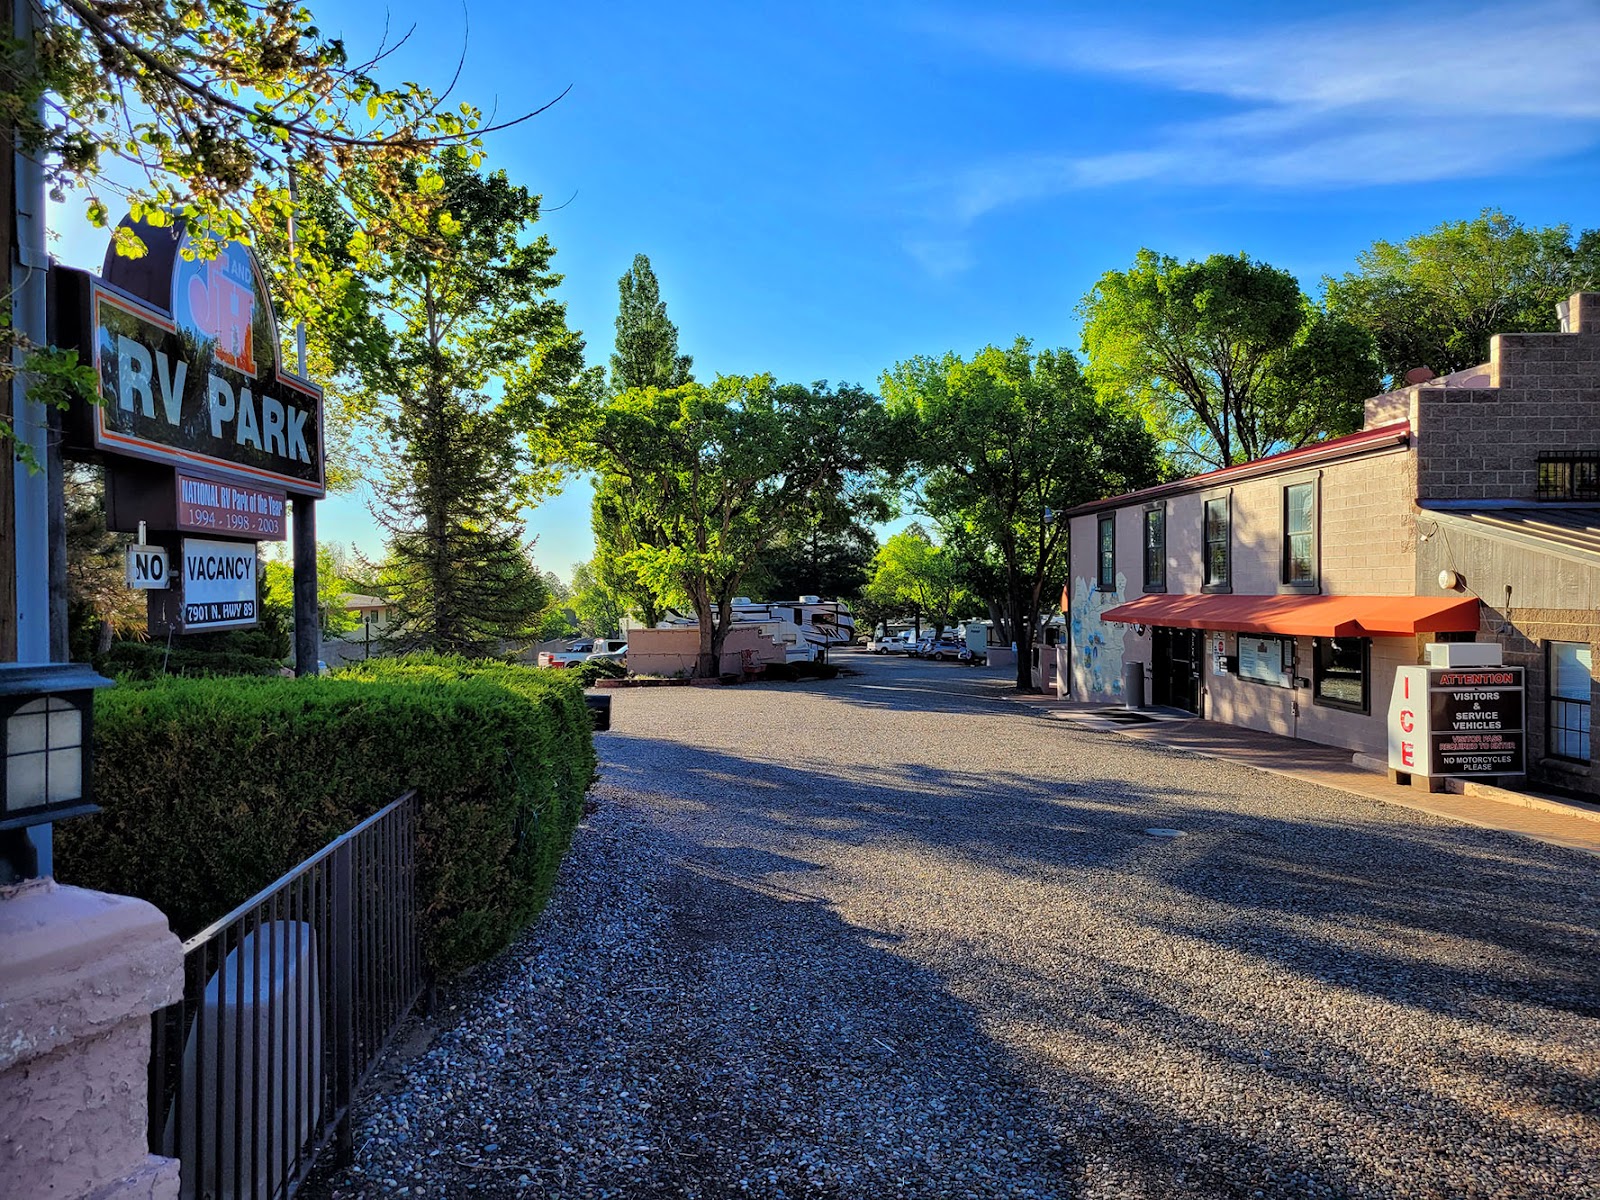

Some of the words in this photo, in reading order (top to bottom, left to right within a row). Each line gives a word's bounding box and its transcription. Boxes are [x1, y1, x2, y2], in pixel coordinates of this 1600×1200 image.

[231, 260, 251, 283] AND
[117, 334, 188, 427] RV
[208, 373, 311, 465] PARK
[182, 479, 220, 508] NATIONAL
[221, 487, 230, 509] RV
[232, 489, 249, 512] Park
[249, 492, 257, 513] of
[257, 492, 268, 514] the
[268, 495, 282, 517] Year
[189, 509, 215, 528] 1994
[226, 514, 249, 530] 1998
[258, 517, 279, 534] 2003
[136, 554, 163, 581] NO
[188, 555, 252, 581] VACANCY
[188, 605, 208, 622] 7901
[211, 604, 221, 619] N.
[222, 603, 242, 619] HWY
[243, 602, 253, 616] 89
[1440, 673, 1513, 684] ATTENTION
[1454, 692, 1500, 701] VISITORS
[1473, 702, 1481, 710] &
[1400, 677, 1414, 767] ICE
[1452, 721, 1502, 730] VEHICLES
[1456, 712, 1498, 720] SERVICE
[1456, 756, 1512, 764] MOTORCYCLES
